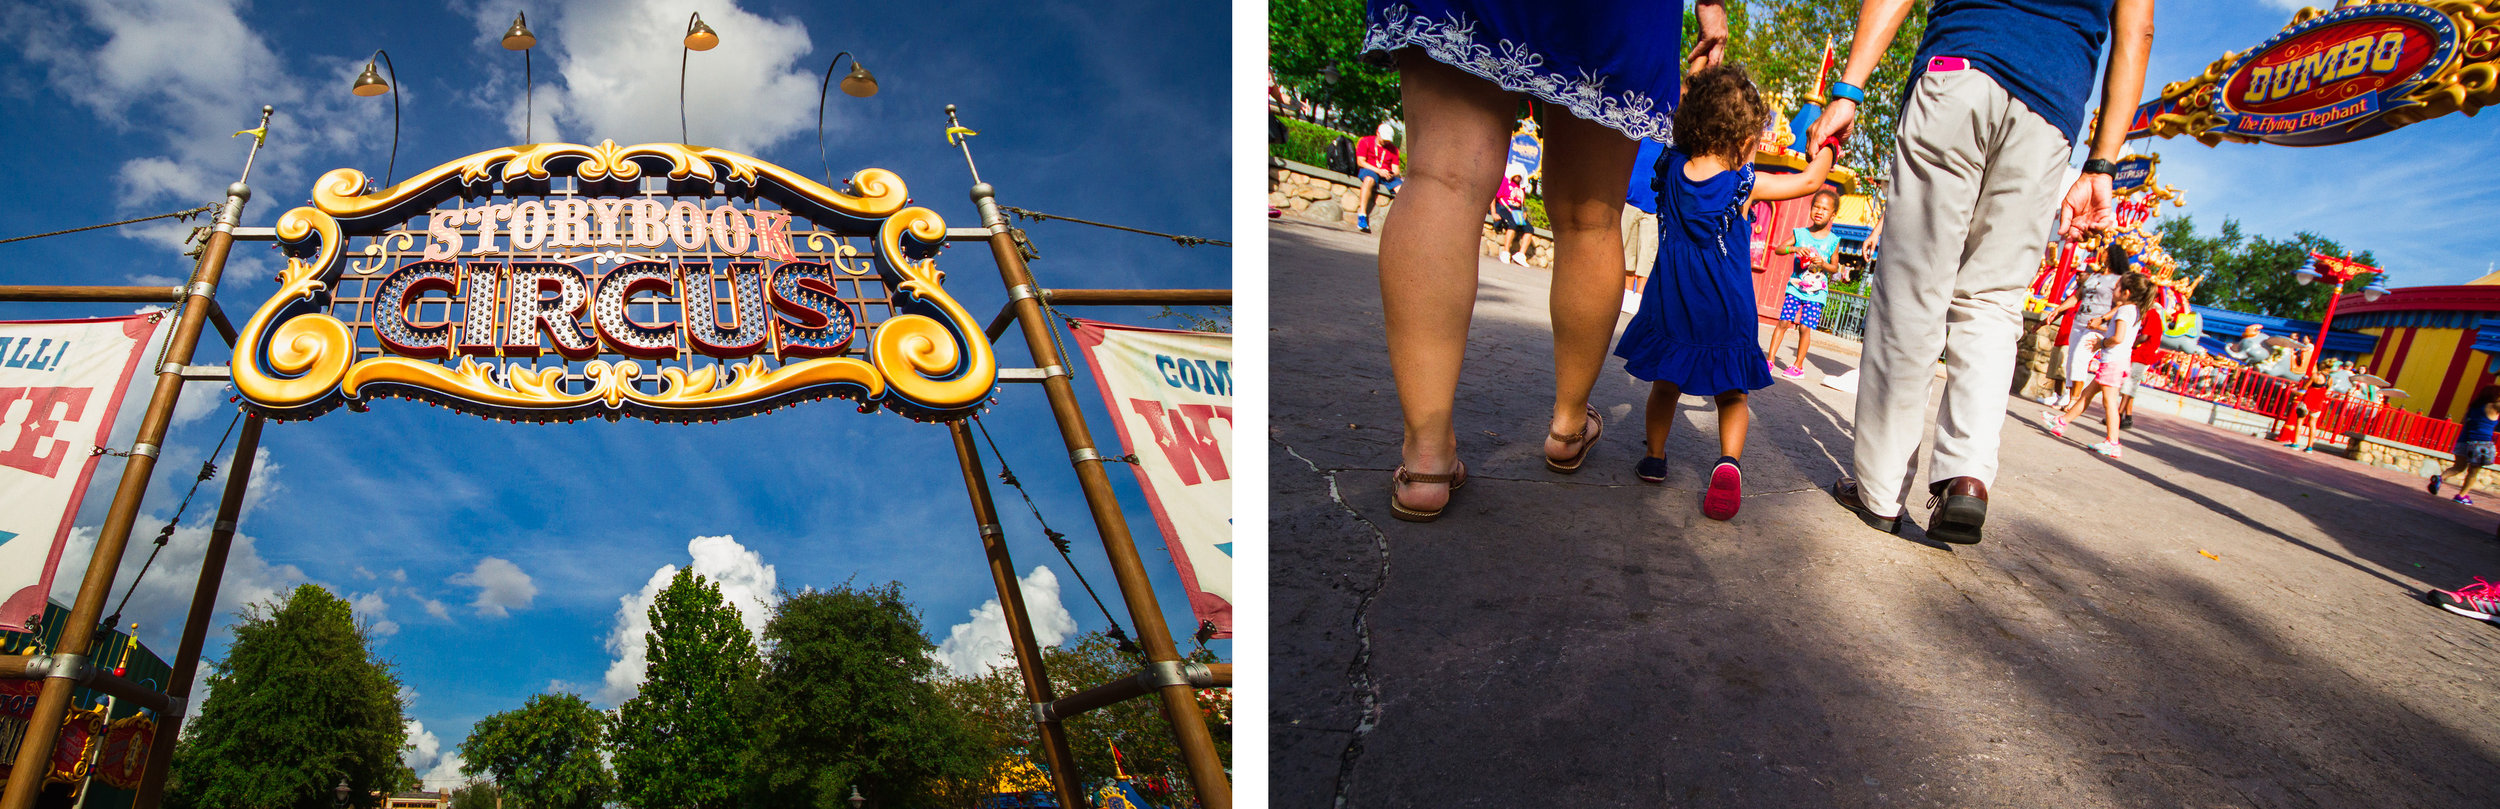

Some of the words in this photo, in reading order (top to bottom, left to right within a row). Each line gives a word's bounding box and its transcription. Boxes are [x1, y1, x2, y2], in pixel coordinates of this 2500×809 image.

[2243, 31, 2406, 102] DUMBO
[2238, 115, 2259, 131] The
[2259, 115, 2298, 133] Flying
[2299, 98, 2369, 128] Elephant
[424, 198, 798, 262] STORYBOOK
[371, 260, 857, 361] CIRCUS
[1155, 353, 1232, 396] COM
